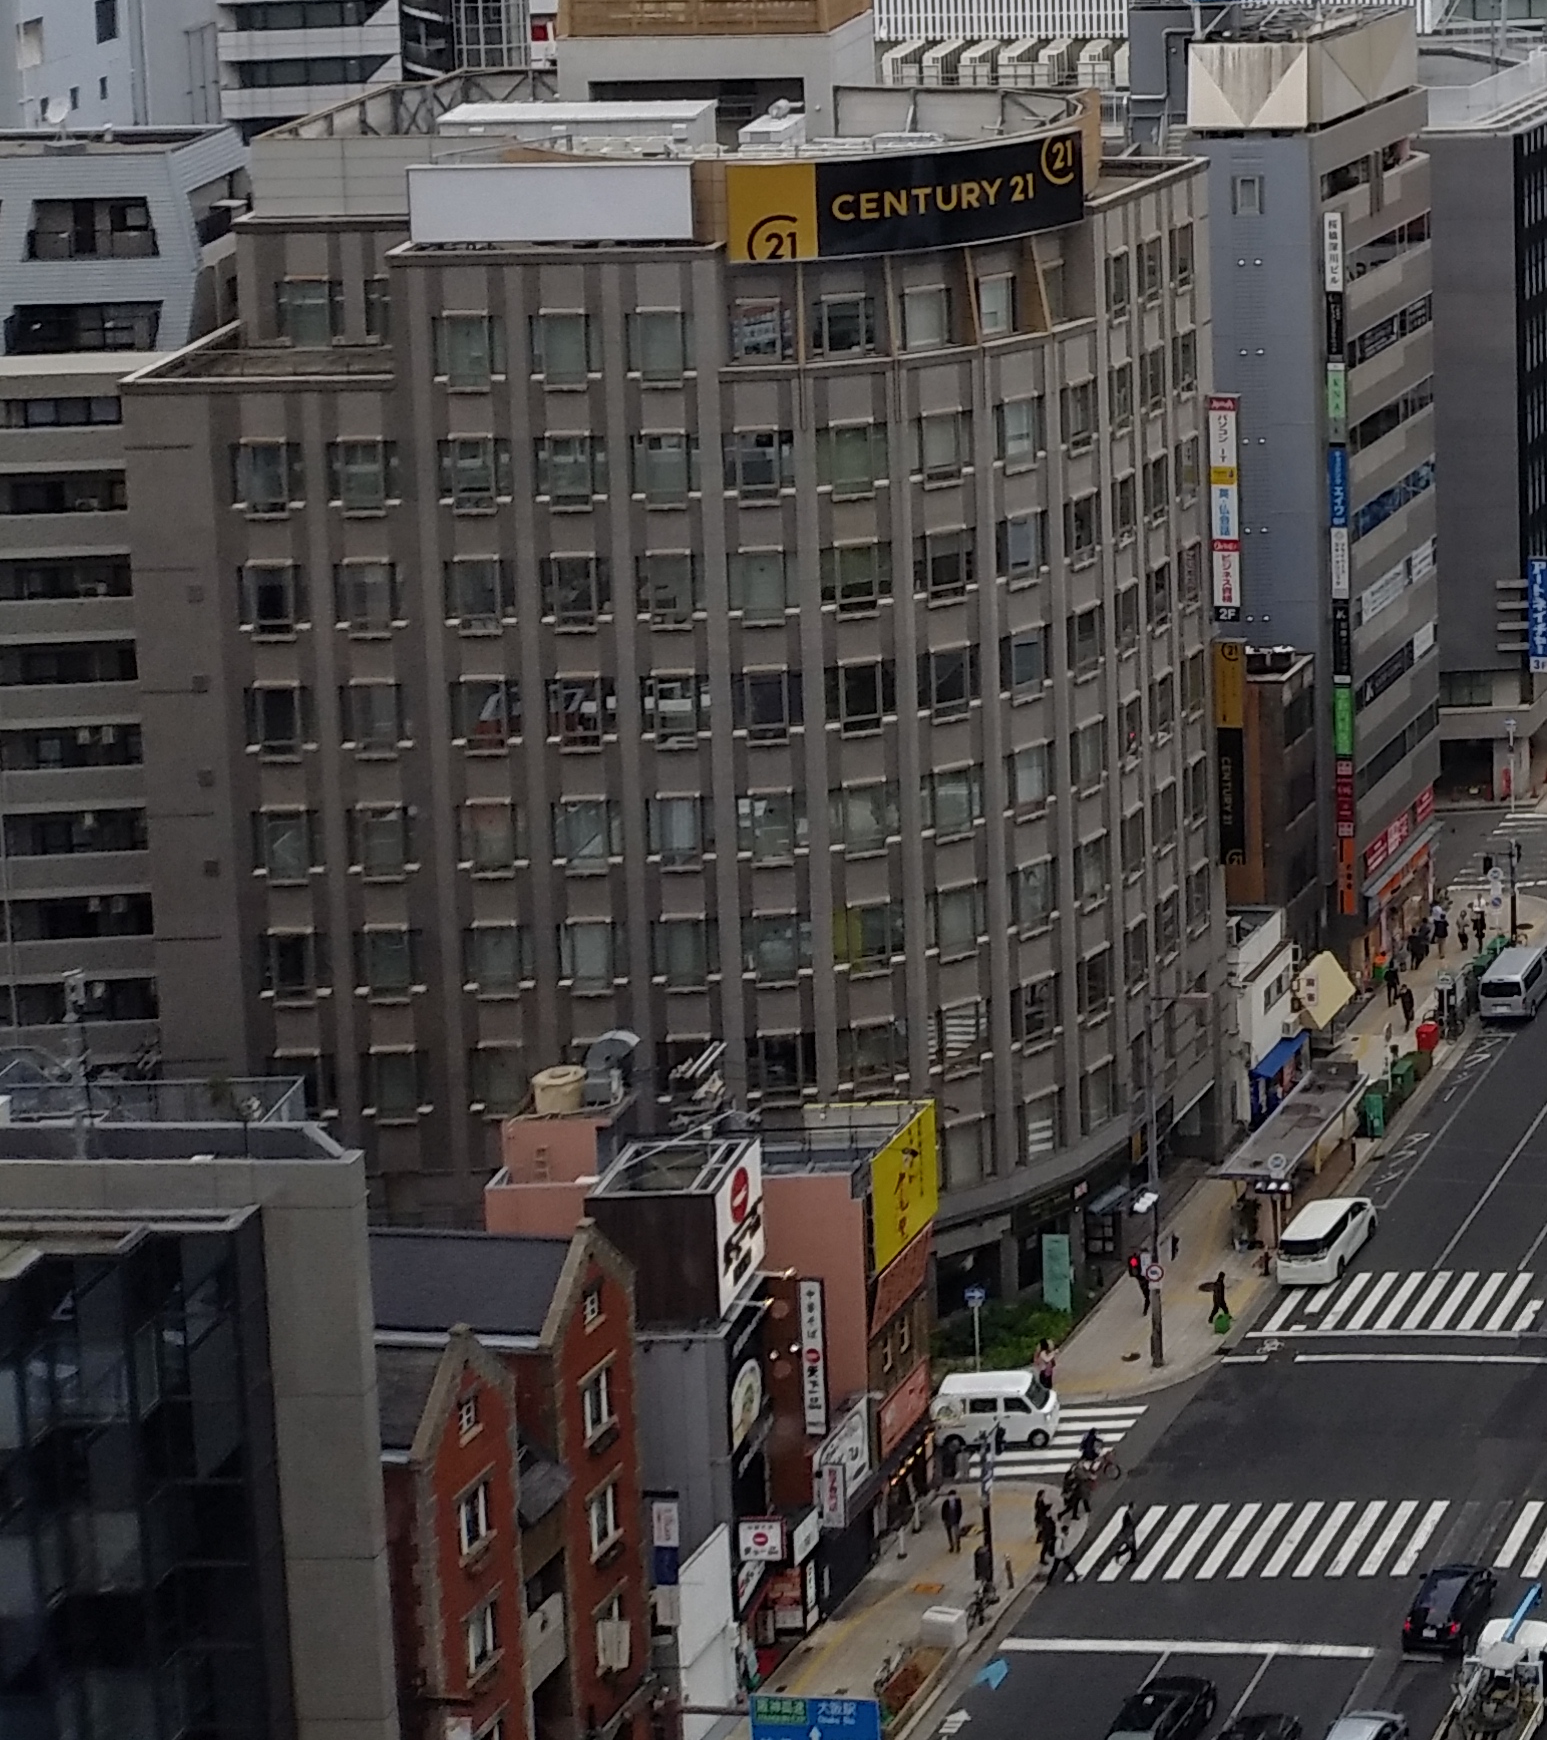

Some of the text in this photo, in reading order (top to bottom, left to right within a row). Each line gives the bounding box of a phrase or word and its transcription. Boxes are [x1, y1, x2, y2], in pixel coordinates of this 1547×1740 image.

[832, 173, 1034, 221] CENTURY 21
[1218, 608, 1236, 621] 2F
[1531, 561, 1547, 655] アートネイチャー
[1221, 756, 1233, 812] CENTURY
